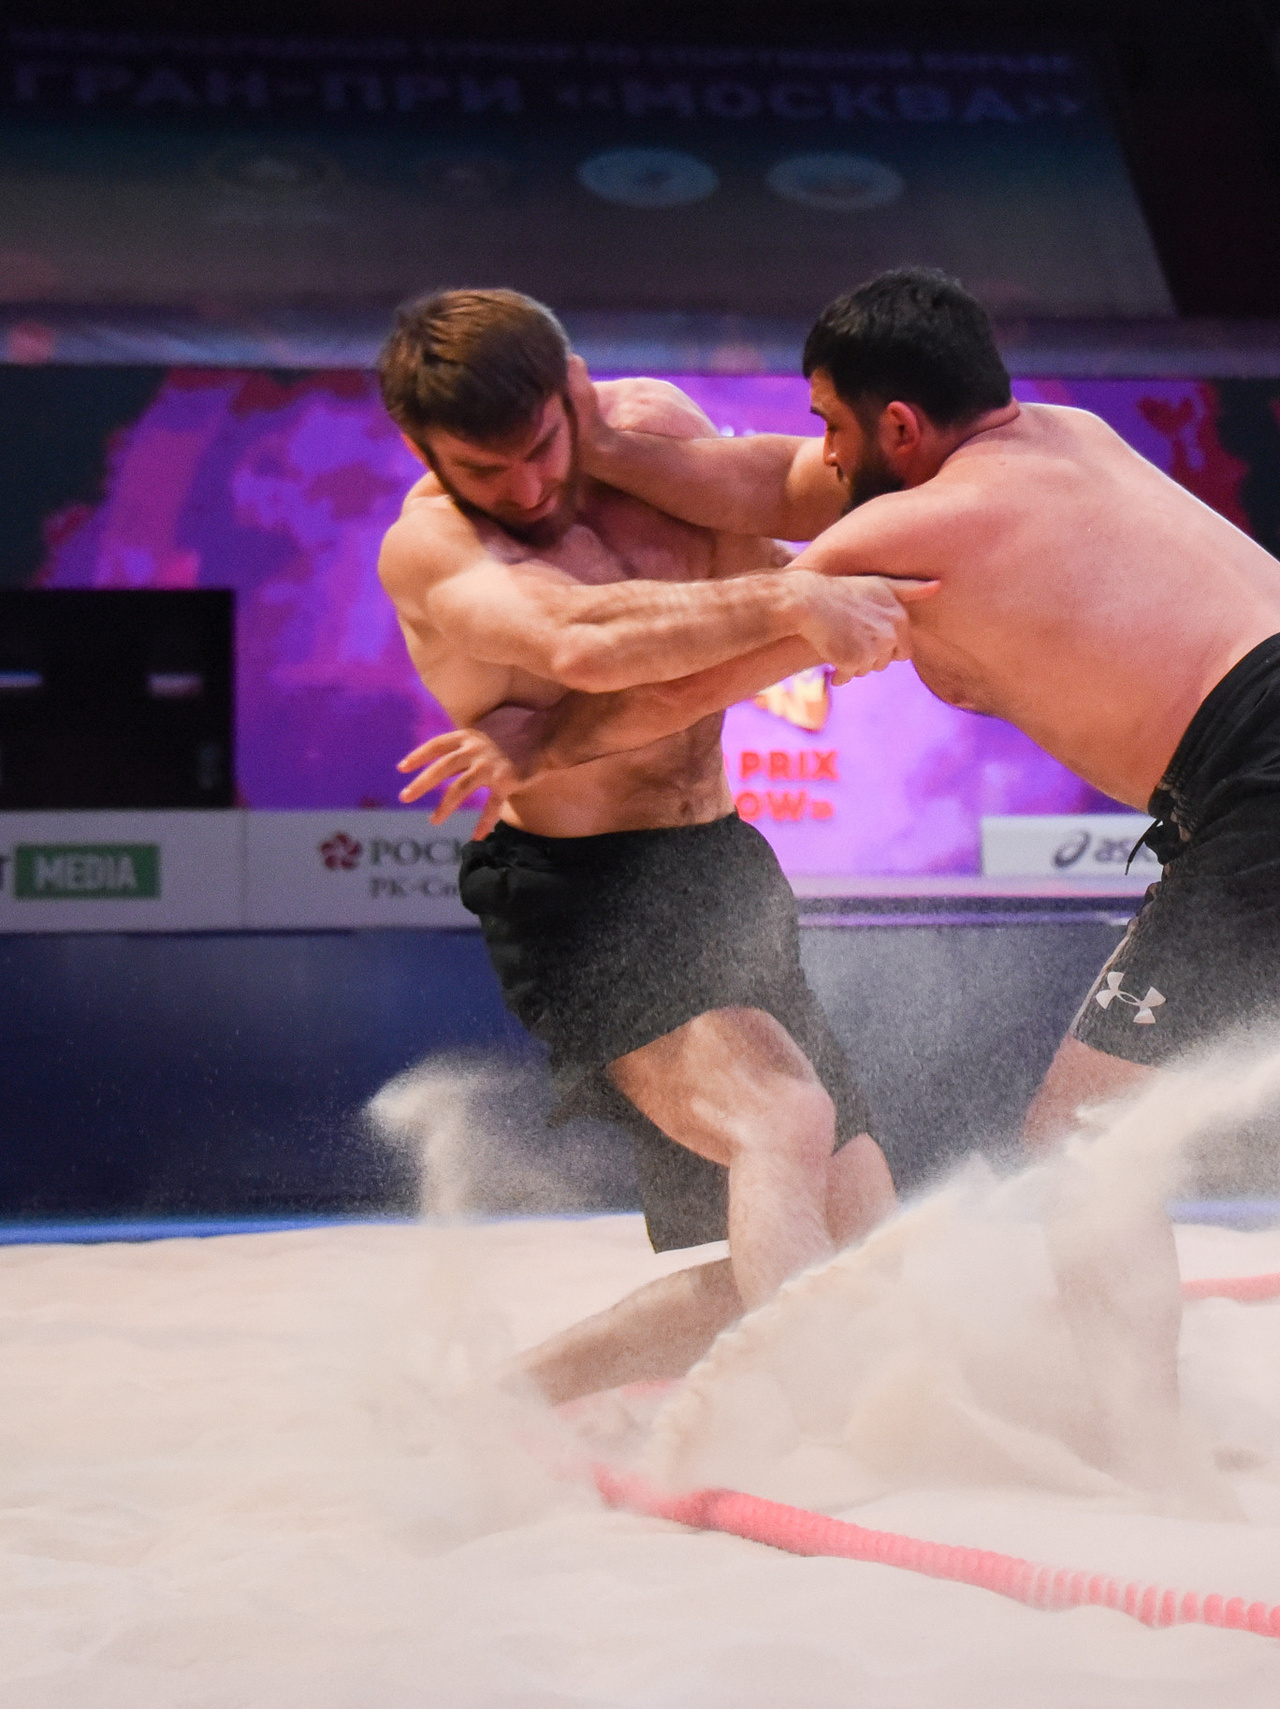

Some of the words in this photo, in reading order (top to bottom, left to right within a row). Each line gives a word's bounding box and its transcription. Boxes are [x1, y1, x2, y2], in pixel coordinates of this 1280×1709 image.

[13, 62, 524, 114] ГРАН-ПРИ
[740, 751, 839, 782] PRIX
[33, 854, 138, 891] MEDIA
